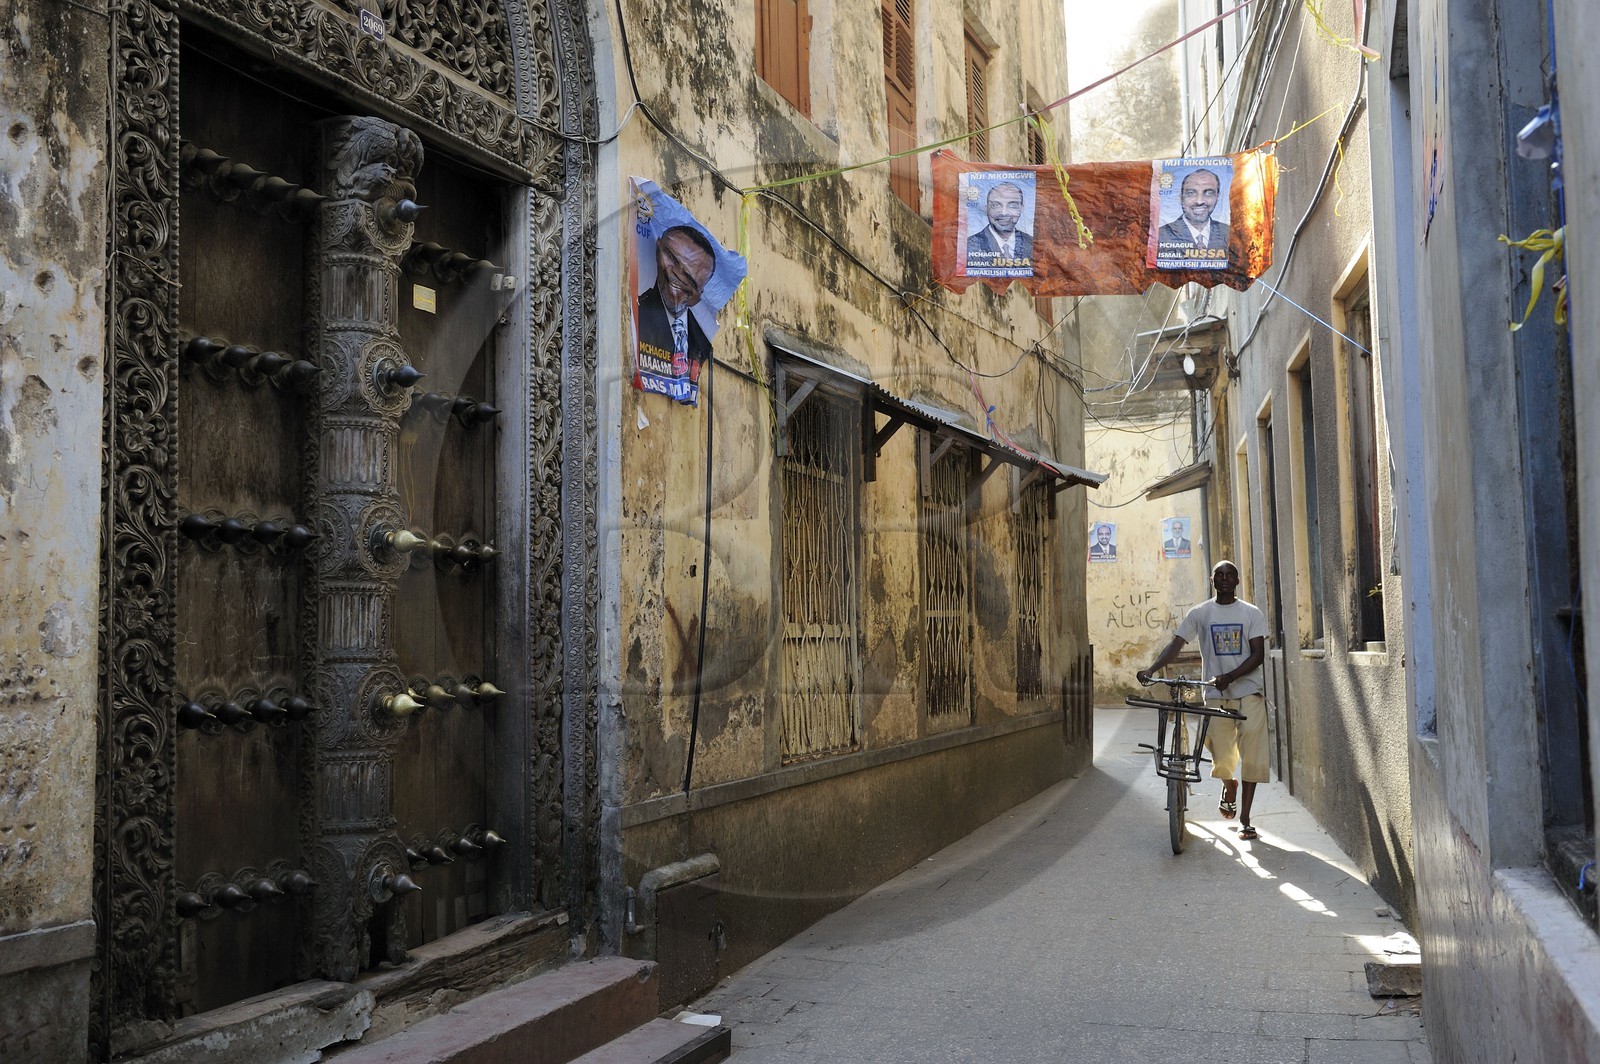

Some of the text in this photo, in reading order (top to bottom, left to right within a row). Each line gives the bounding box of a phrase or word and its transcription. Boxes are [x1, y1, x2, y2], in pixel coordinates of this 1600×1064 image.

[363, 15, 382, 34] 2069
[988, 172, 1035, 180] MKONGWE
[636, 223, 651, 239] CUF
[991, 257, 1031, 267] JUSSA
[1183, 248, 1226, 259] JUSSA
[639, 341, 672, 362] MCHAGUE
[639, 353, 673, 375] MAALIM
[641, 376, 668, 394] RAIS
[1112, 591, 1160, 609] CUF
